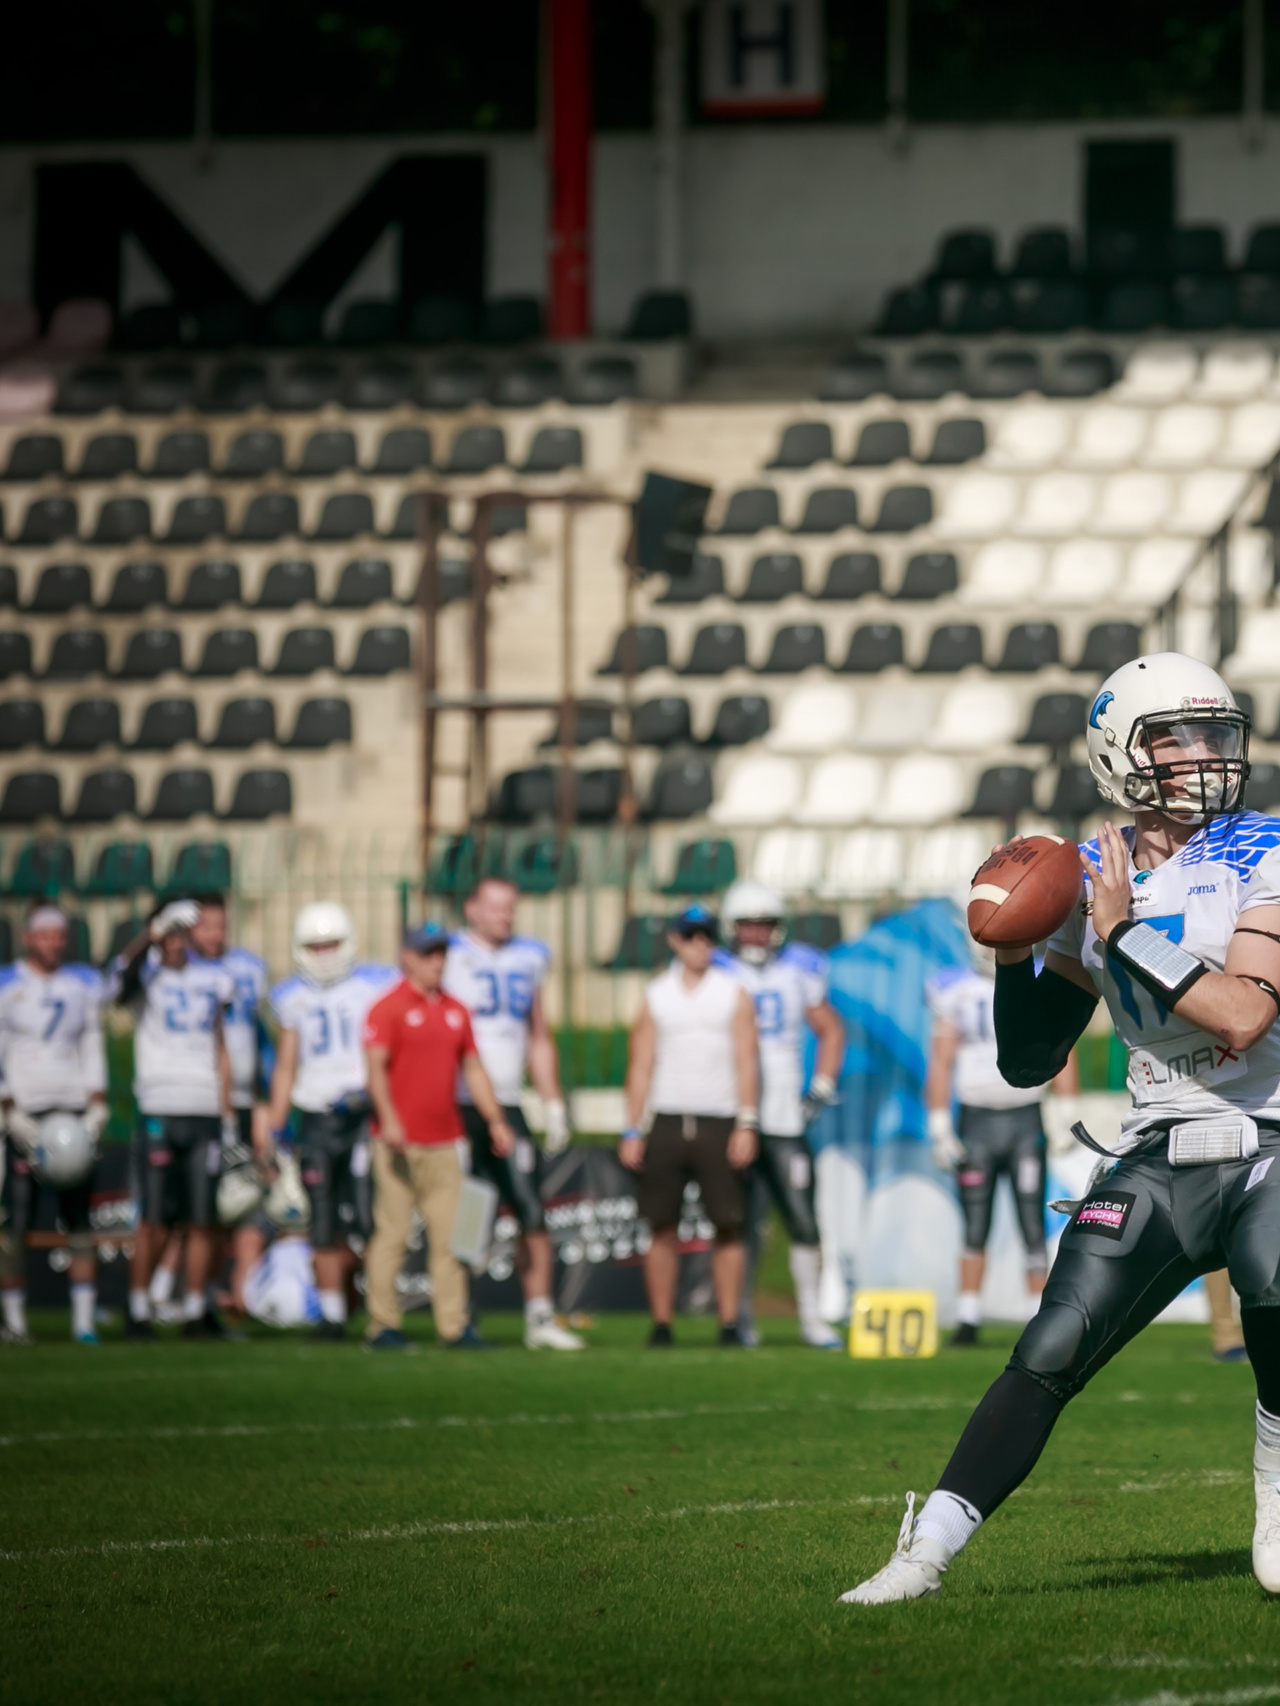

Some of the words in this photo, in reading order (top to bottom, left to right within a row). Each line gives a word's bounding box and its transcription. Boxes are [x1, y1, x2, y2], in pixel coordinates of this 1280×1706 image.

[730, 0, 794, 87] H
[1083, 1200, 1128, 1213] Hotel
[1083, 1210, 1120, 1220] TYCHY
[865, 1308, 924, 1357] 40
